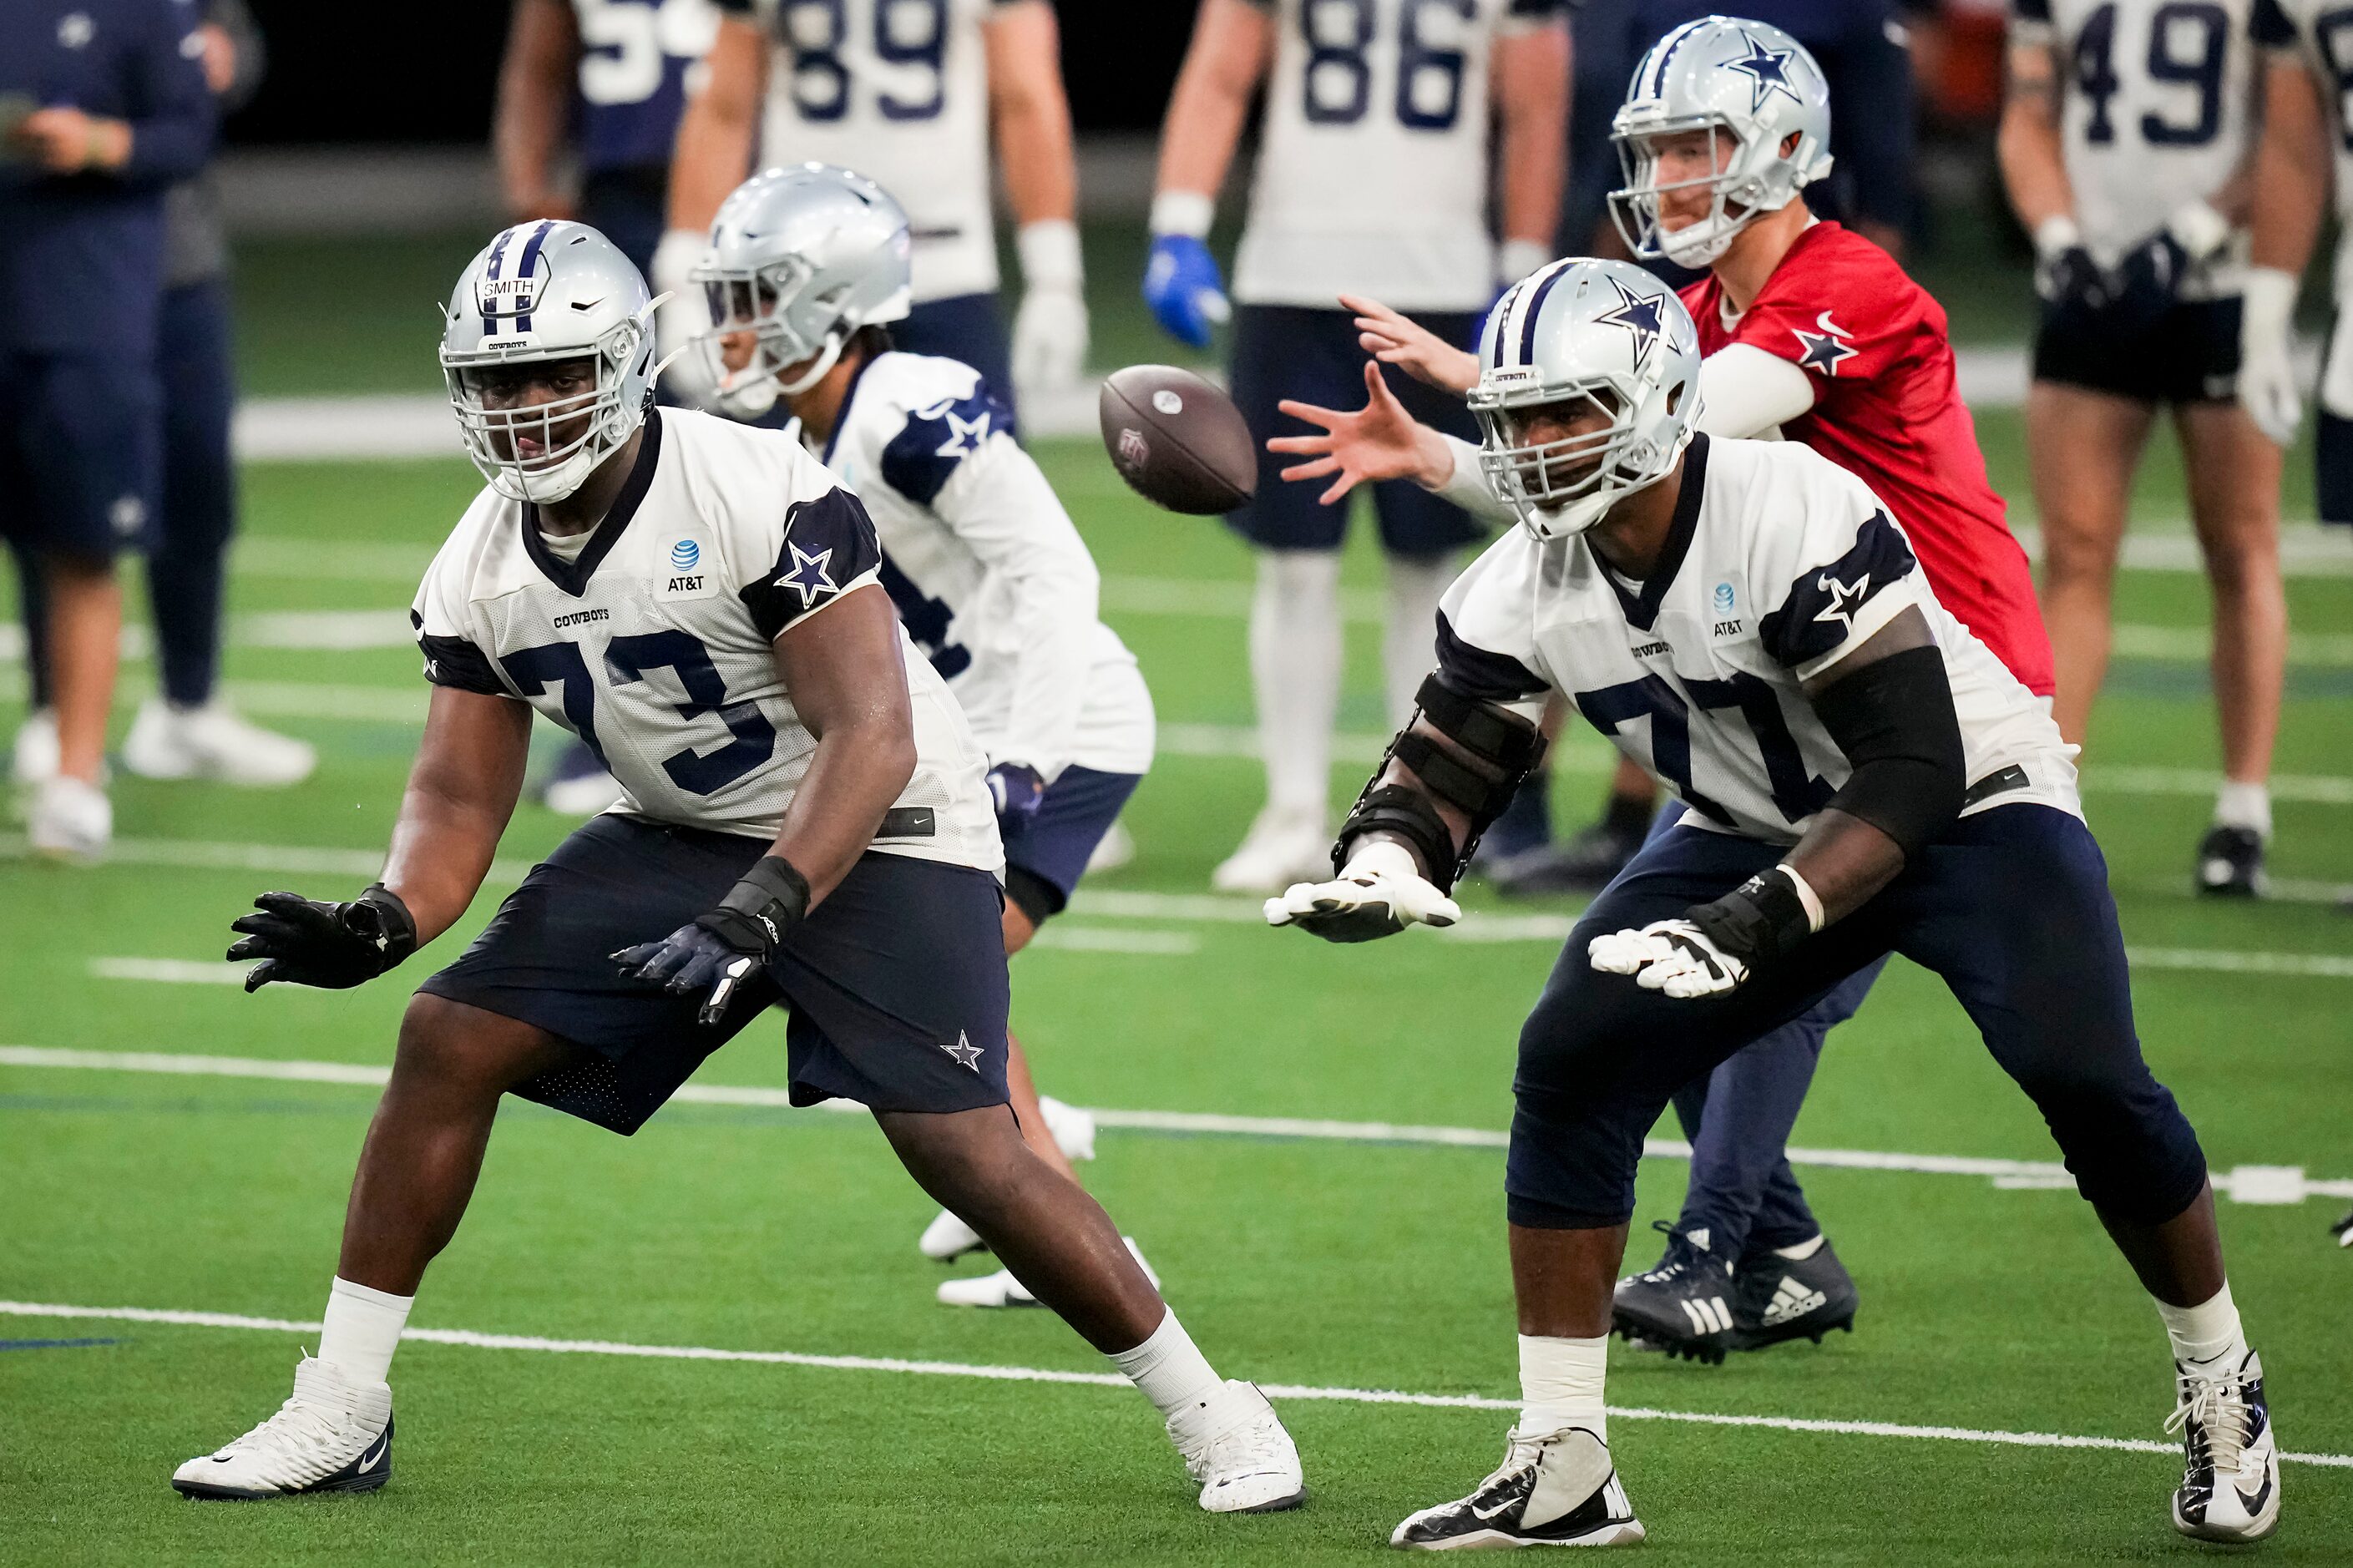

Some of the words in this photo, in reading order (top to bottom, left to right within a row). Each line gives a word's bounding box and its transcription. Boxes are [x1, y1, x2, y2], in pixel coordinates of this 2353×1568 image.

[778, 0, 949, 123] 89
[1301, 0, 1476, 131] 86
[2075, 3, 2230, 144] 49
[484, 280, 534, 296] SMITH
[488, 341, 528, 351] COWBOYS
[554, 609, 610, 629] COWBOYS
[668, 575, 704, 592] AT&T
[1714, 619, 1743, 637] AT&T
[496, 628, 776, 797] 73
[1575, 670, 1838, 827] 77
